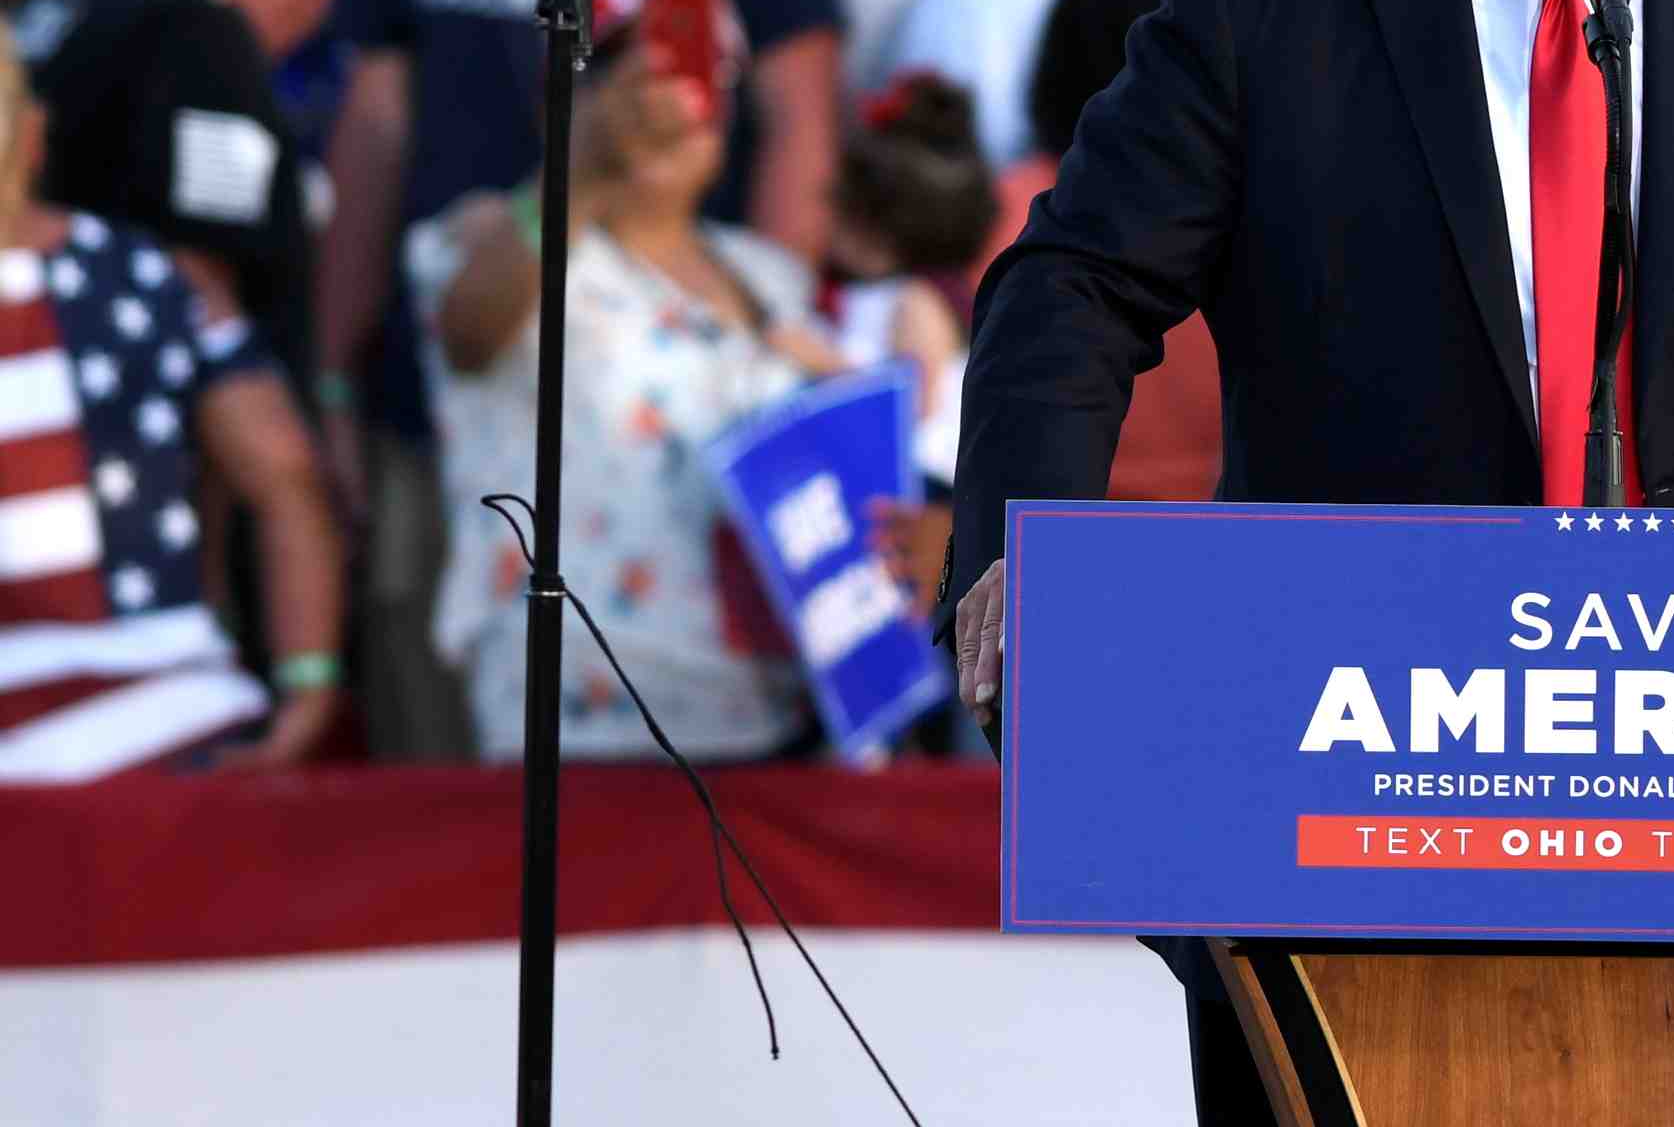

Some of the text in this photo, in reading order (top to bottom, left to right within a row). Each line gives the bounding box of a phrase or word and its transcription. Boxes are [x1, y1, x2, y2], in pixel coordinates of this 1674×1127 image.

[1374, 773, 1556, 797] PRESIDENT
[1355, 826, 1474, 856] TEXT
[1501, 828, 1623, 858] OHIO
